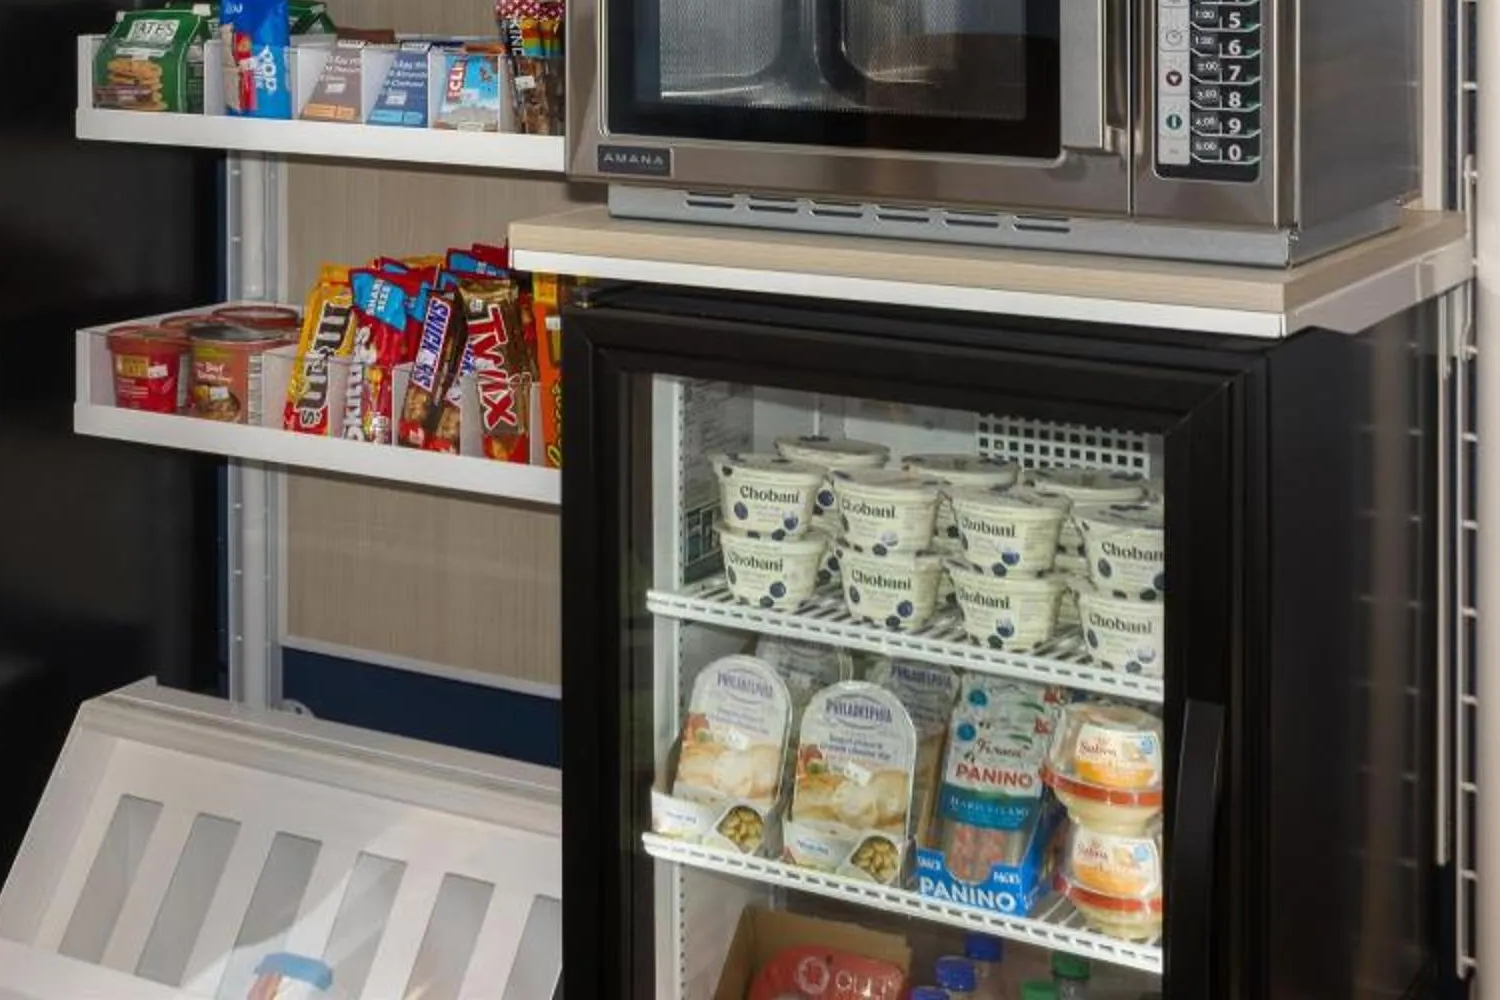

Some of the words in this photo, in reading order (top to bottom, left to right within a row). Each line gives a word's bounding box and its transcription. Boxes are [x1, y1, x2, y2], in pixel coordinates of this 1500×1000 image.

[1229, 12, 1242, 29] 5
[1229, 39, 1242, 56] 6
[1229, 65, 1242, 82] 7
[1229, 92, 1242, 108] 8
[1229, 117, 1242, 135] 9
[603, 153, 664, 165] AMANA
[1229, 144, 1242, 162] 0
[377, 284, 391, 313] SIZE
[740, 485, 800, 504] Chobani
[729, 551, 783, 571] Chobani
[851, 570, 912, 591] Chobani
[1089, 612, 1153, 634] Chobani
[825, 698, 893, 724] PHILADELPHIA
[955, 762, 1034, 790] PANINO
[919, 875, 1018, 912] PANINO
